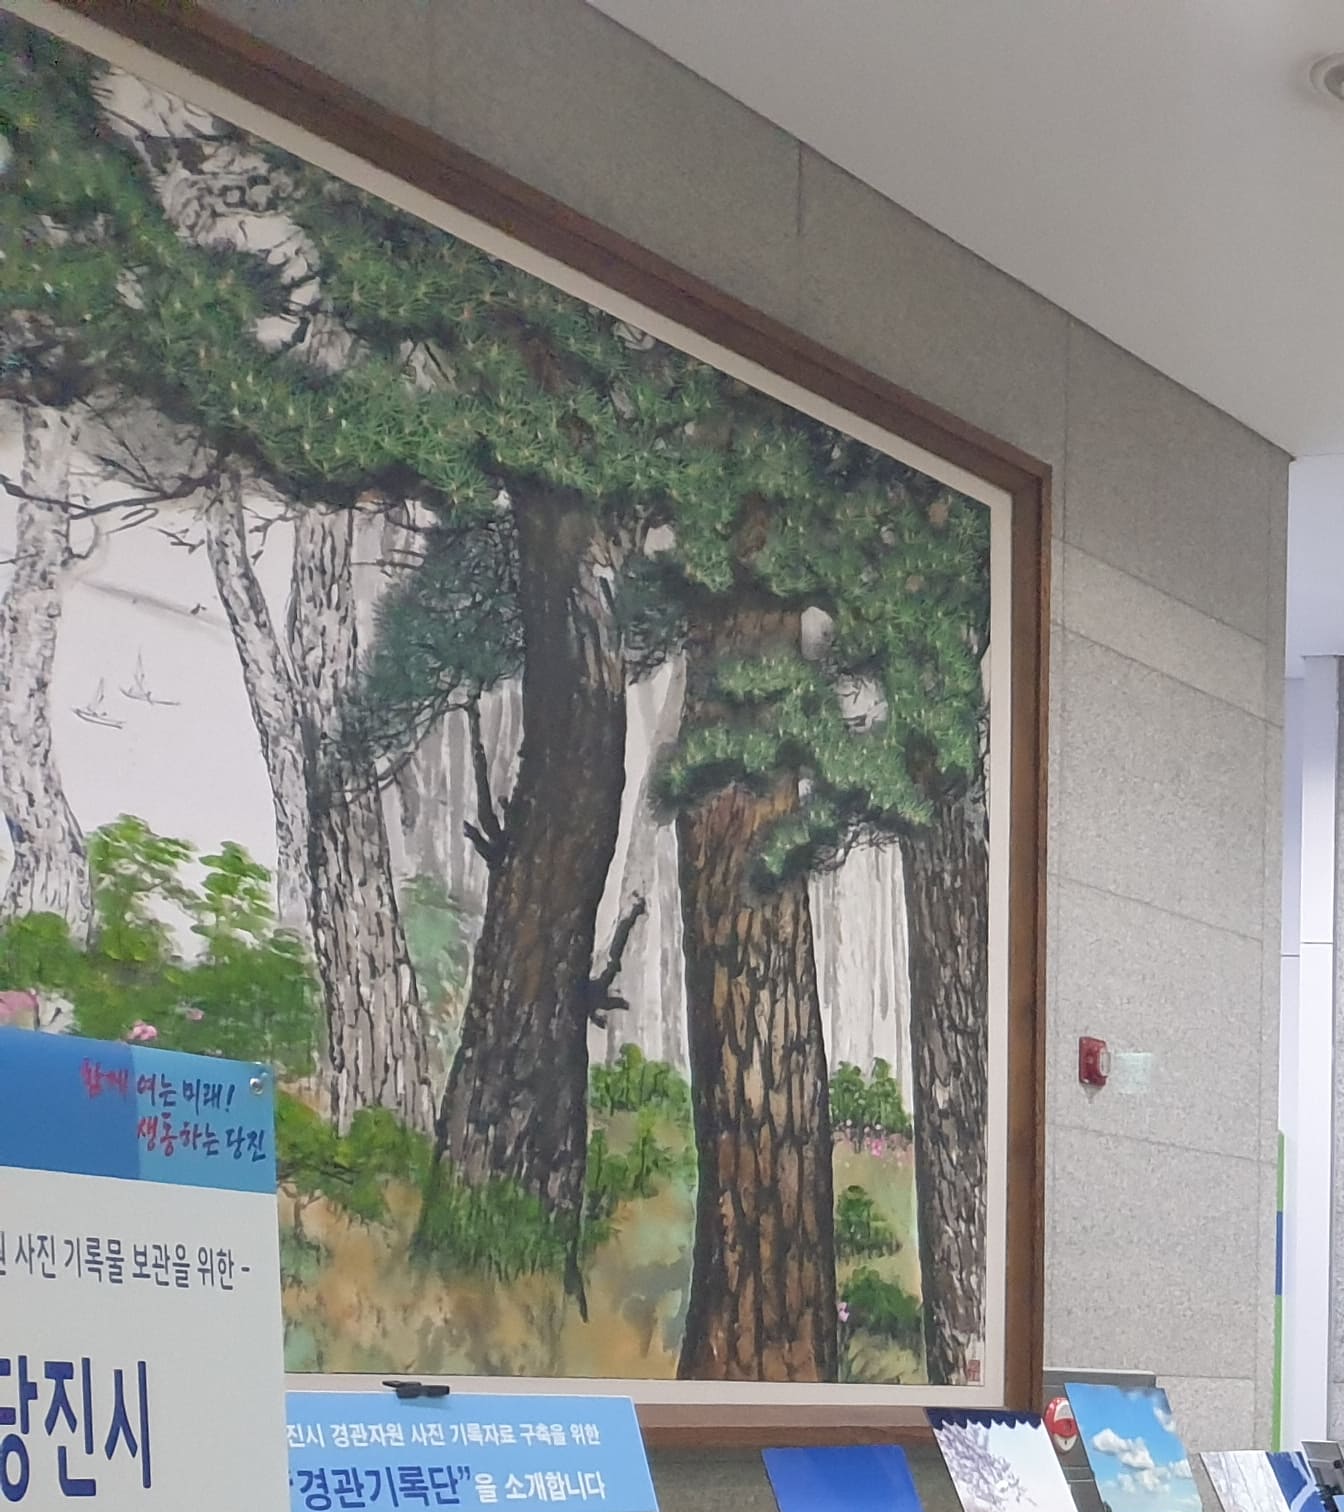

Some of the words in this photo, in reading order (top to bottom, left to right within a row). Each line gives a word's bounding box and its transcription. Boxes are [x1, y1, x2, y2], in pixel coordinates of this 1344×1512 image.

[136, 1073, 177, 1107] 여는
[182, 1078, 236, 1115] 미래!
[137, 1112, 220, 1157] 생동하는
[225, 1126, 267, 1162] 당진
[15, 1233, 57, 1279] 사진
[64, 1236, 125, 1284] 기록물
[132, 1243, 191, 1289] 보관을
[330, 1423, 405, 1448] 경관자원
[411, 1423, 446, 1446] 사진
[570, 1423, 600, 1446] 위한
[505, 1471, 606, 1501] 소개합니다
